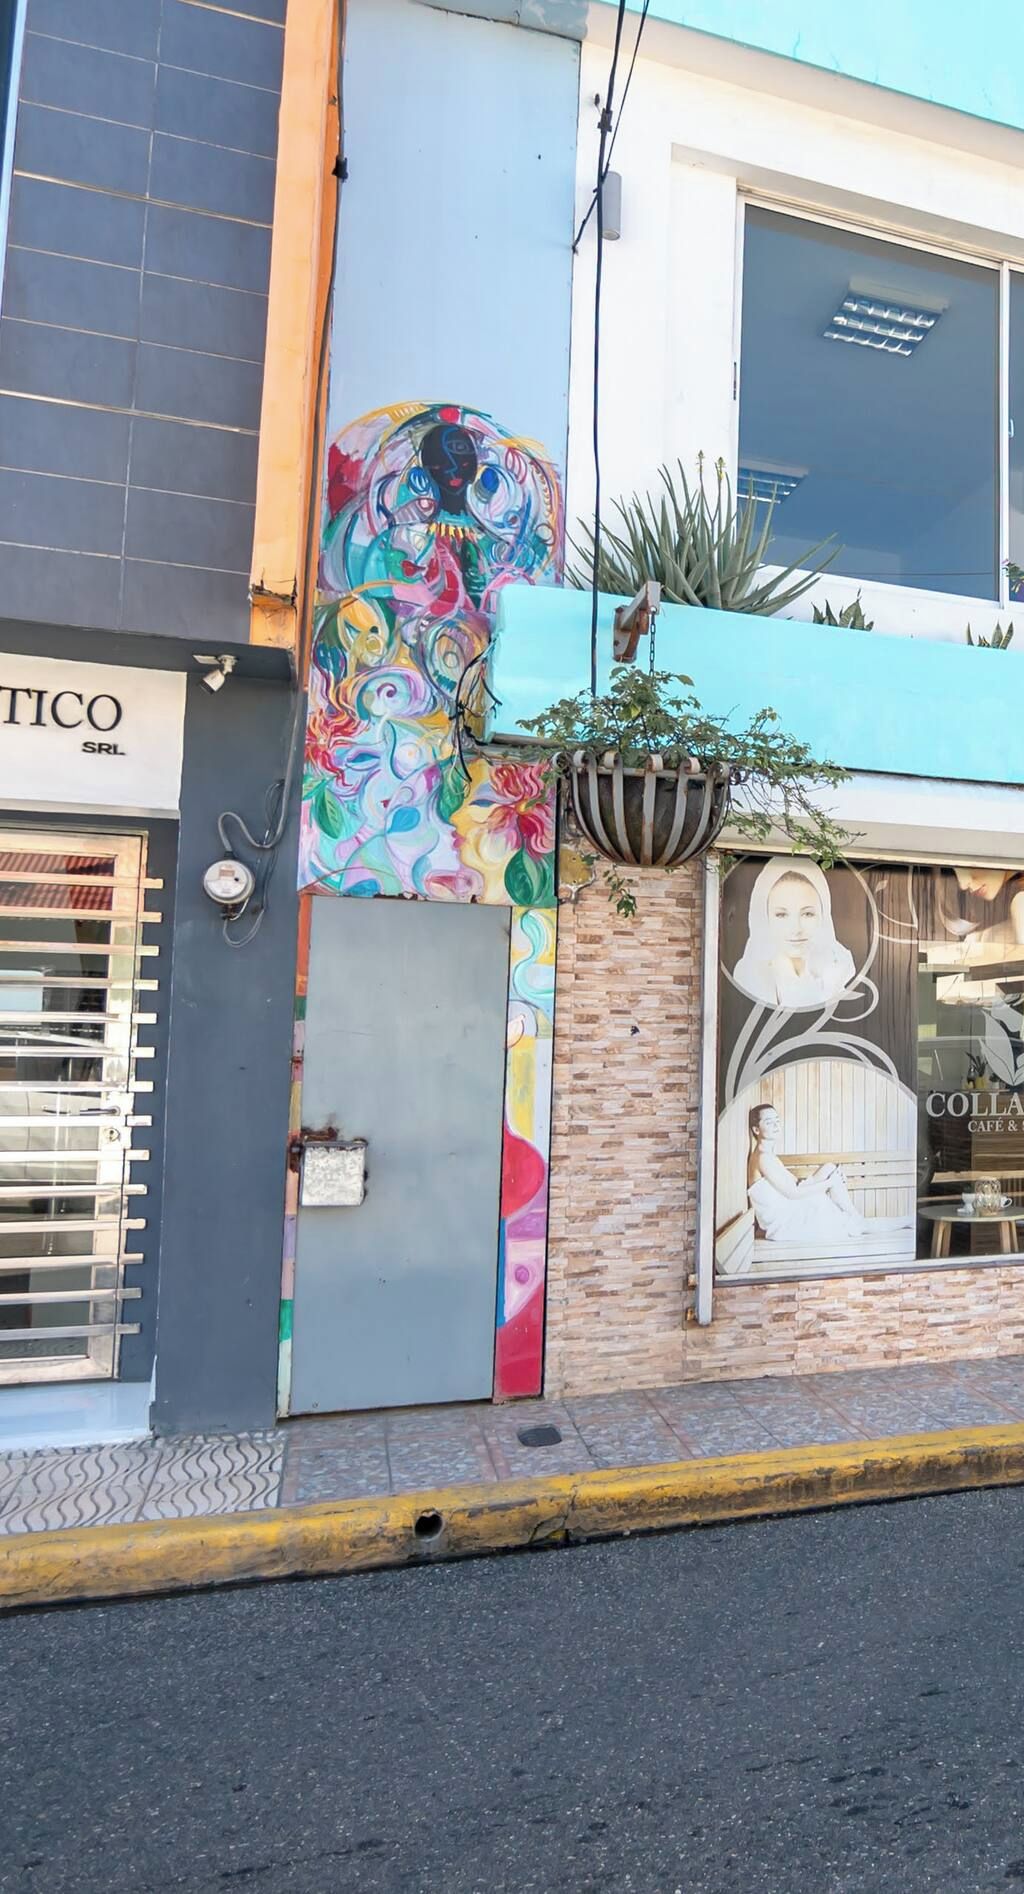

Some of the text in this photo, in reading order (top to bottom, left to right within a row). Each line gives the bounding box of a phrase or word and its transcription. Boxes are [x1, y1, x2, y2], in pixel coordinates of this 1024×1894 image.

[0, 685, 123, 732] TICO
[81, 741, 126, 756] SRL
[967, 1117, 1004, 1133] CAFÉ
[1007, 1119, 1018, 1132] &
